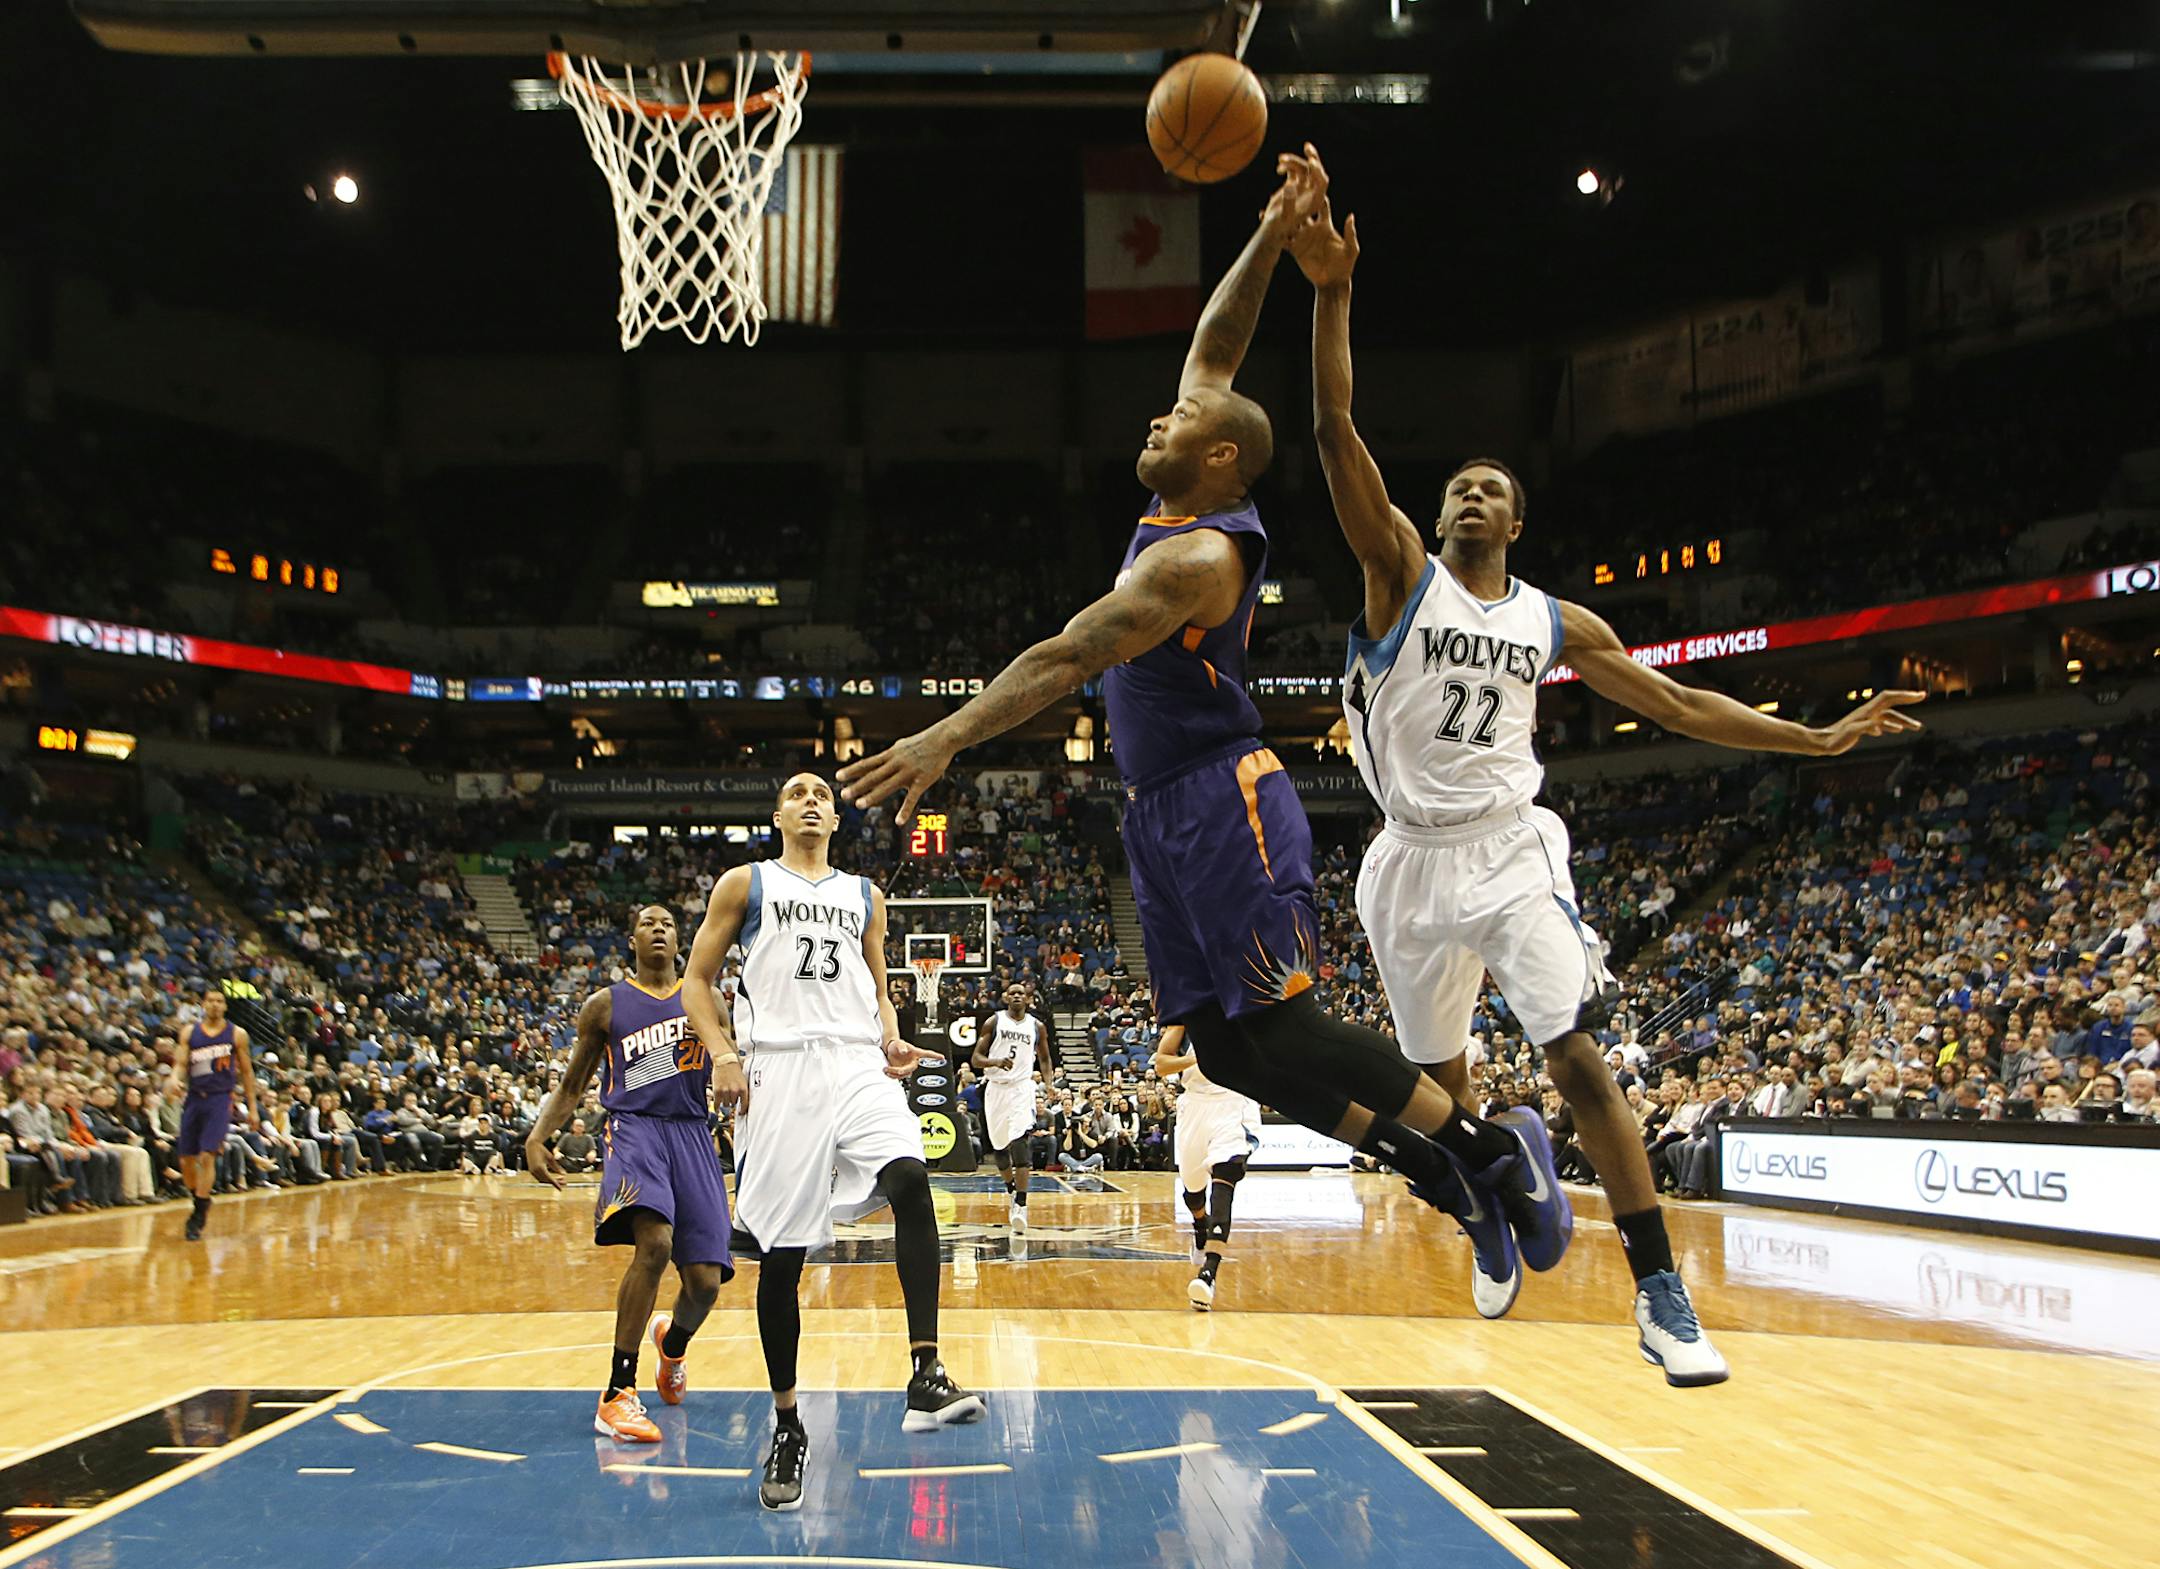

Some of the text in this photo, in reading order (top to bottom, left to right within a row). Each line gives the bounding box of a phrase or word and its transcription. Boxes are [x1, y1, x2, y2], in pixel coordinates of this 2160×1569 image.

[2044, 216, 2123, 257] 225
[1702, 311, 1764, 350] 224
[1418, 626, 1541, 685] WOLVES
[1631, 628, 1767, 667] PRINT SERVICES
[842, 679, 875, 695] 46
[920, 679, 984, 696] 3:03
[1434, 680, 1503, 748] 22
[549, 779, 606, 793] Treasure
[610, 776, 653, 793] Island
[655, 776, 701, 793] Resort
[702, 777, 716, 793] &
[719, 775, 768, 792] Casino
[1317, 775, 1345, 790] VIP
[911, 830, 944, 855] 21
[769, 899, 861, 942] WOLVES
[795, 933, 843, 983] 23
[949, 1016, 977, 1047] G
[1000, 1029, 1031, 1046] WOLVES
[678, 1039, 706, 1072] 20
[1009, 1045, 1017, 1060] 5
[1754, 1153, 1828, 1181] LEXUS
[1952, 1165, 2069, 1204] LEXUS
